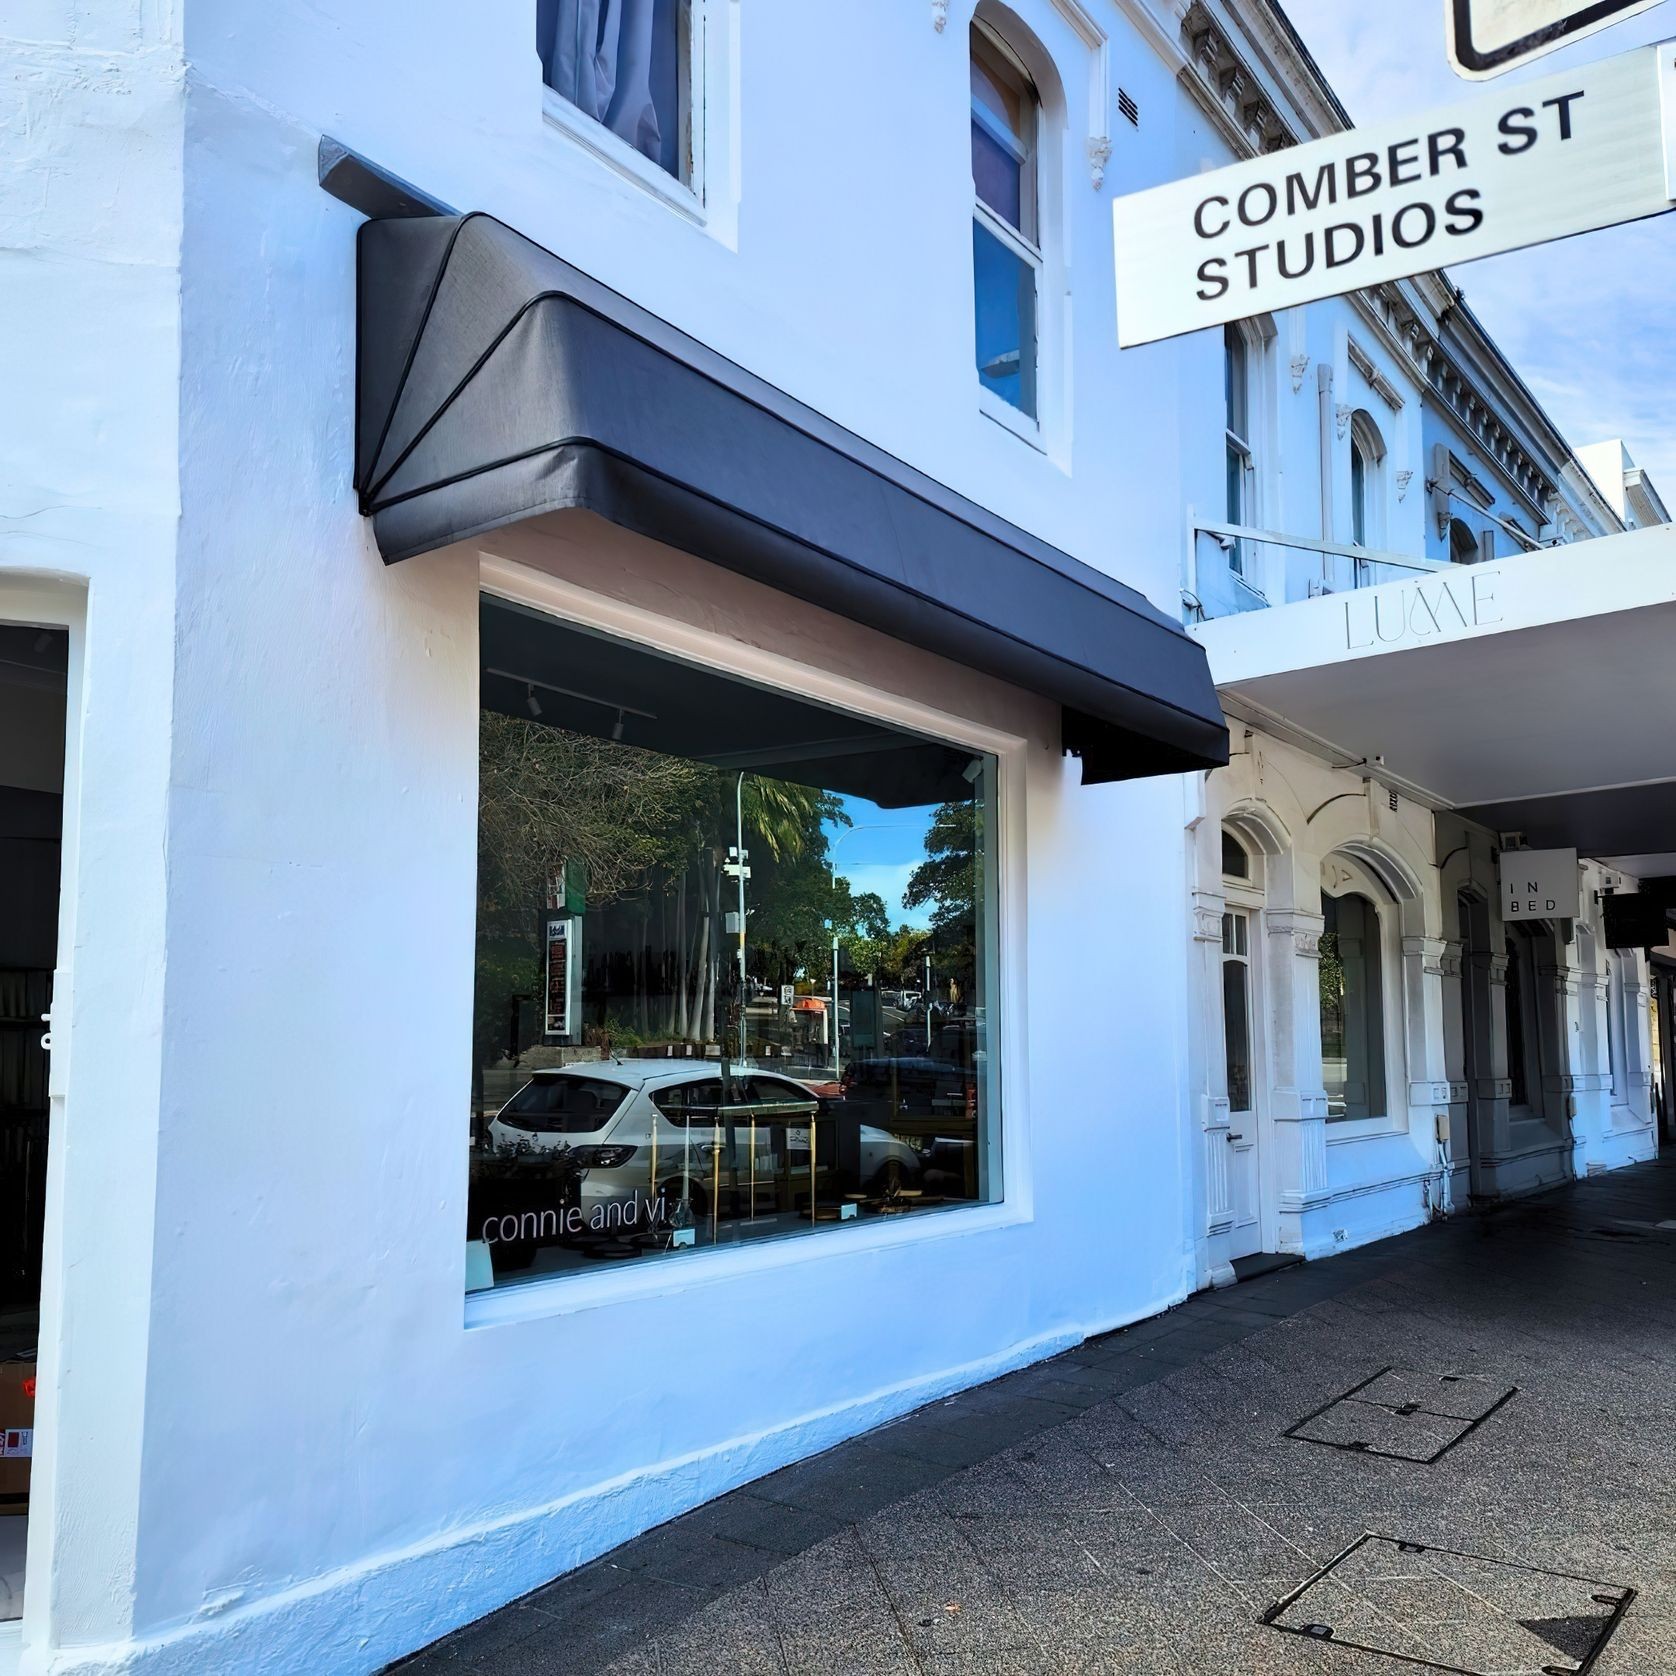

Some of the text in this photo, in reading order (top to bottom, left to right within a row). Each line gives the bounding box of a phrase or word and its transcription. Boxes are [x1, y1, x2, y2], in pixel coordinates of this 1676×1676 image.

[1193, 89, 1585, 239] COMBER ST
[1196, 188, 1485, 302] STUDIOS
[1510, 881, 1539, 894] IN
[1510, 899, 1556, 912] BED
[481, 1198, 583, 1245] connie
[590, 1188, 639, 1230] and
